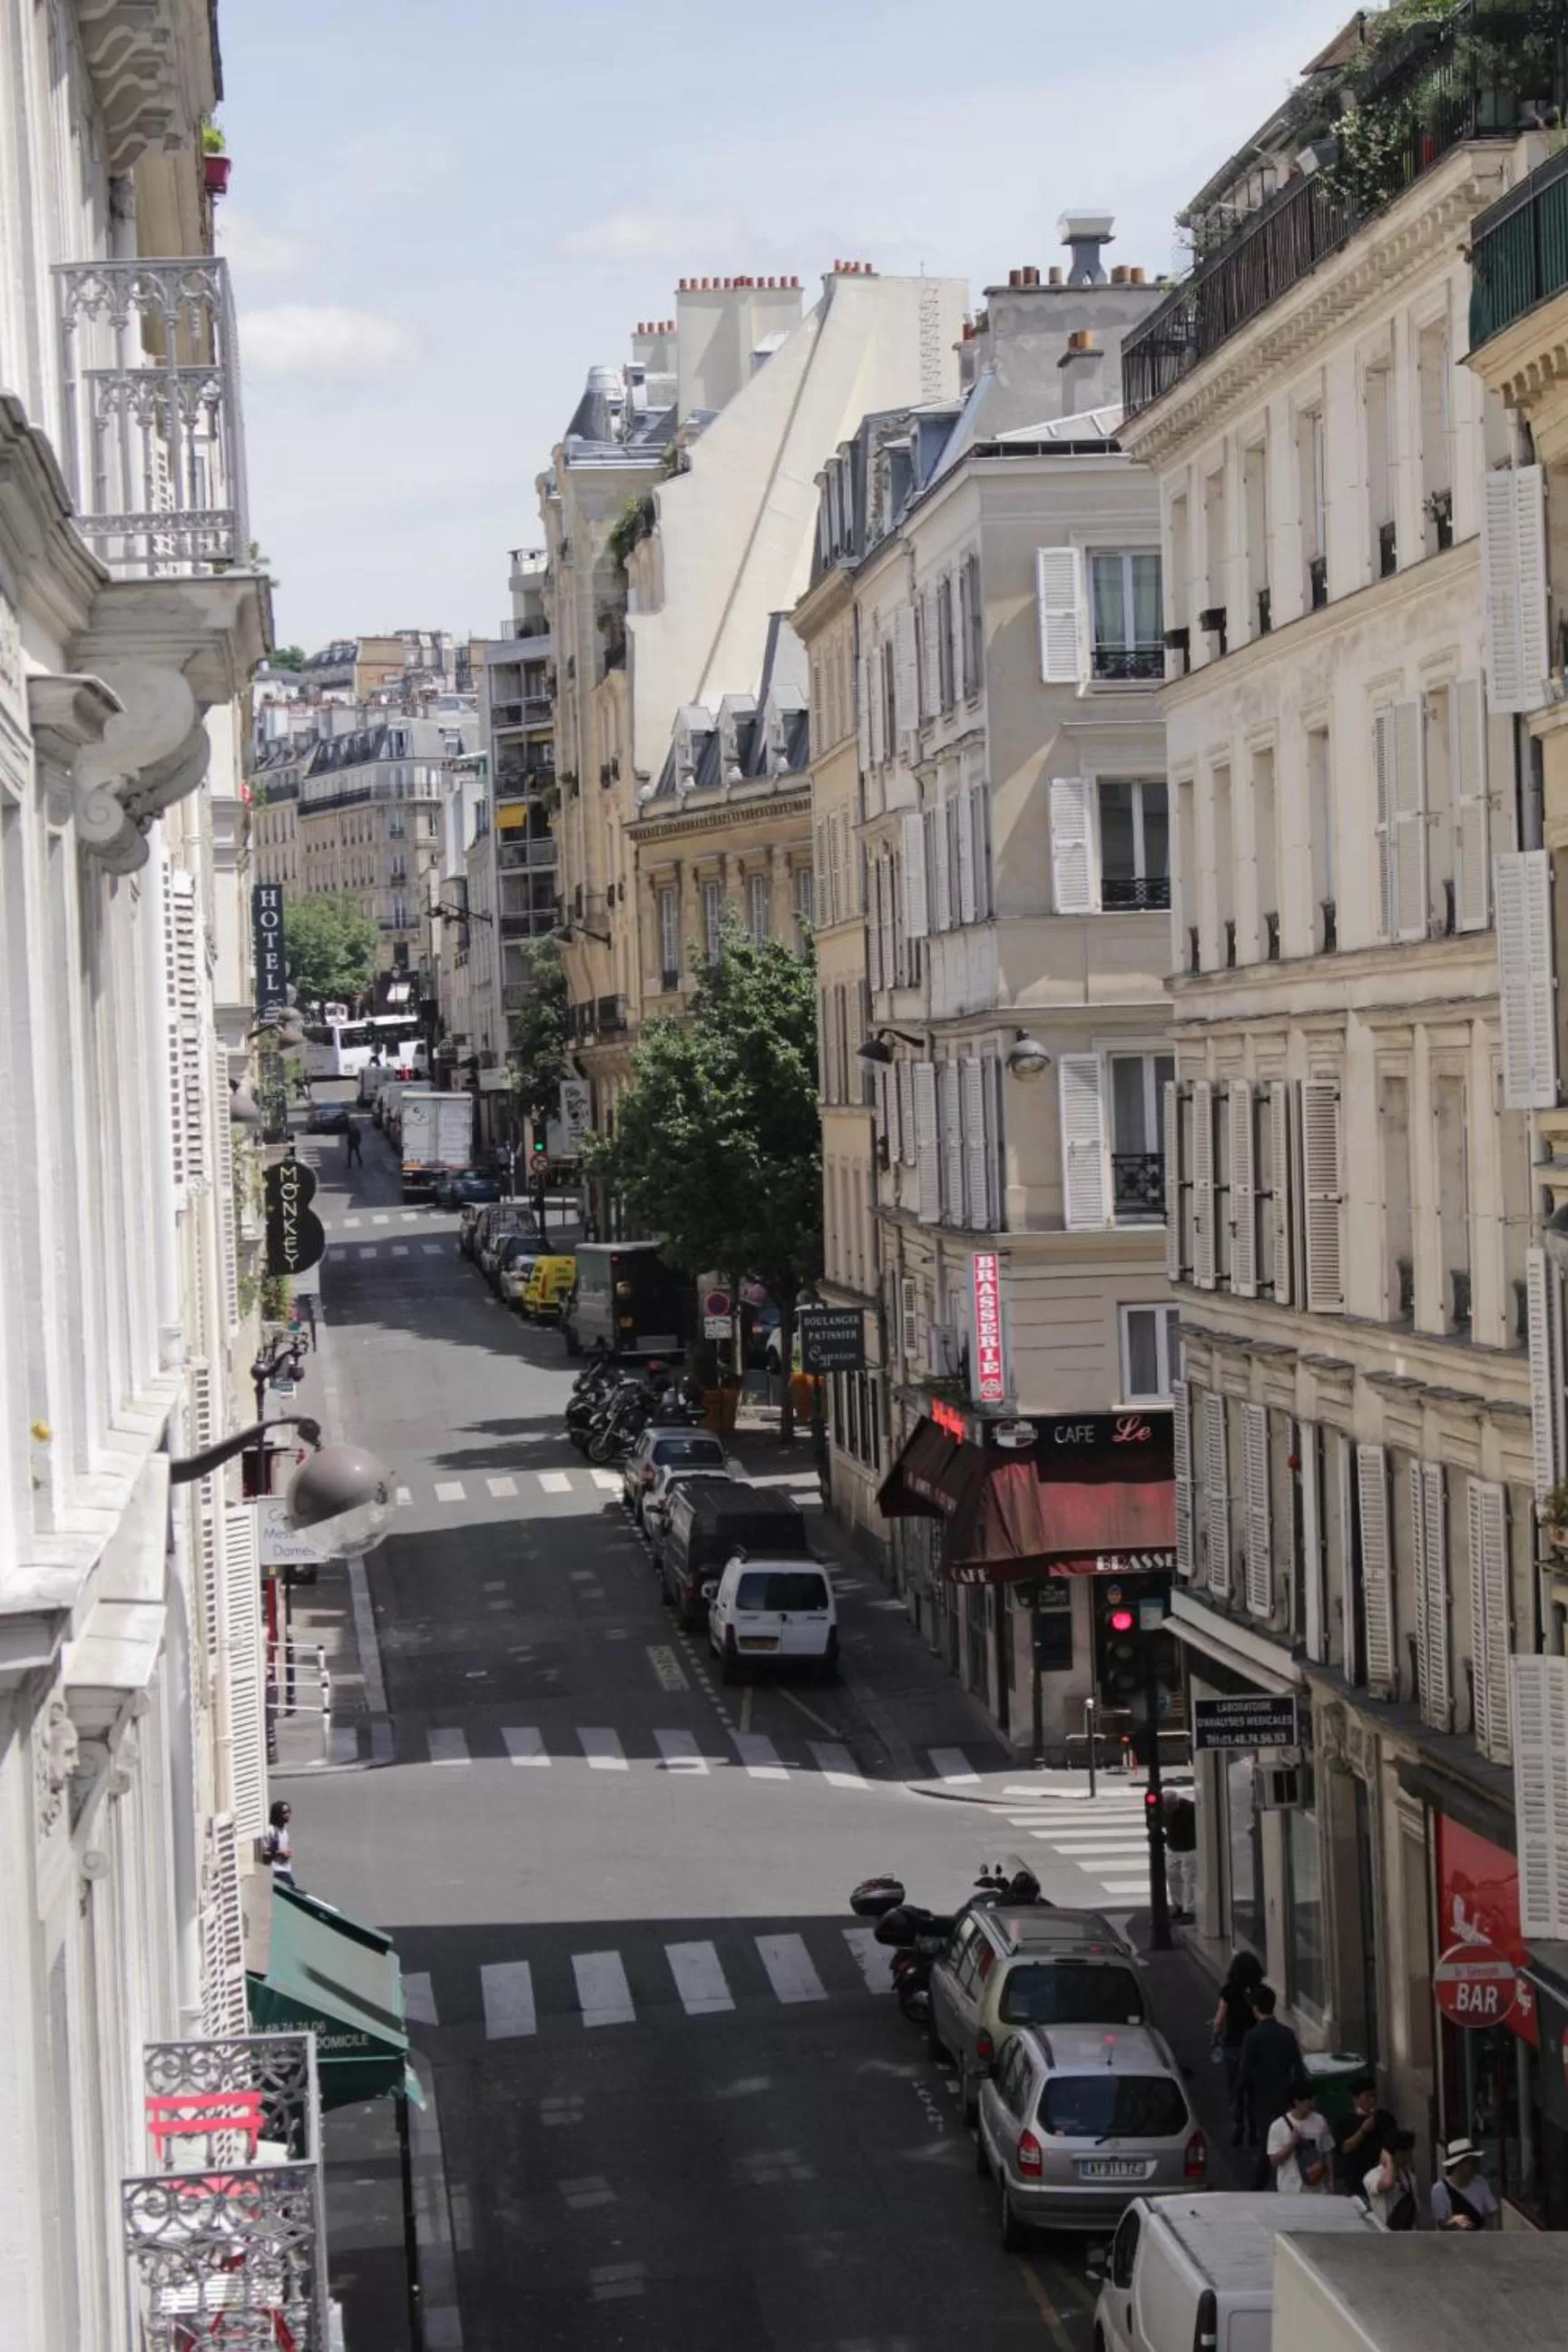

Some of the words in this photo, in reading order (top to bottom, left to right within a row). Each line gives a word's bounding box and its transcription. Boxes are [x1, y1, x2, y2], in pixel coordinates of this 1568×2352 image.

[260, 890, 279, 990] HOTEL
[280, 1166, 300, 1270] MONKEY
[976, 1256, 999, 1375] BRASSERIE
[1054, 1426, 1094, 1443] CAFE
[1112, 1415, 1152, 1442] Le
[1456, 1983, 1497, 2013] BAR
